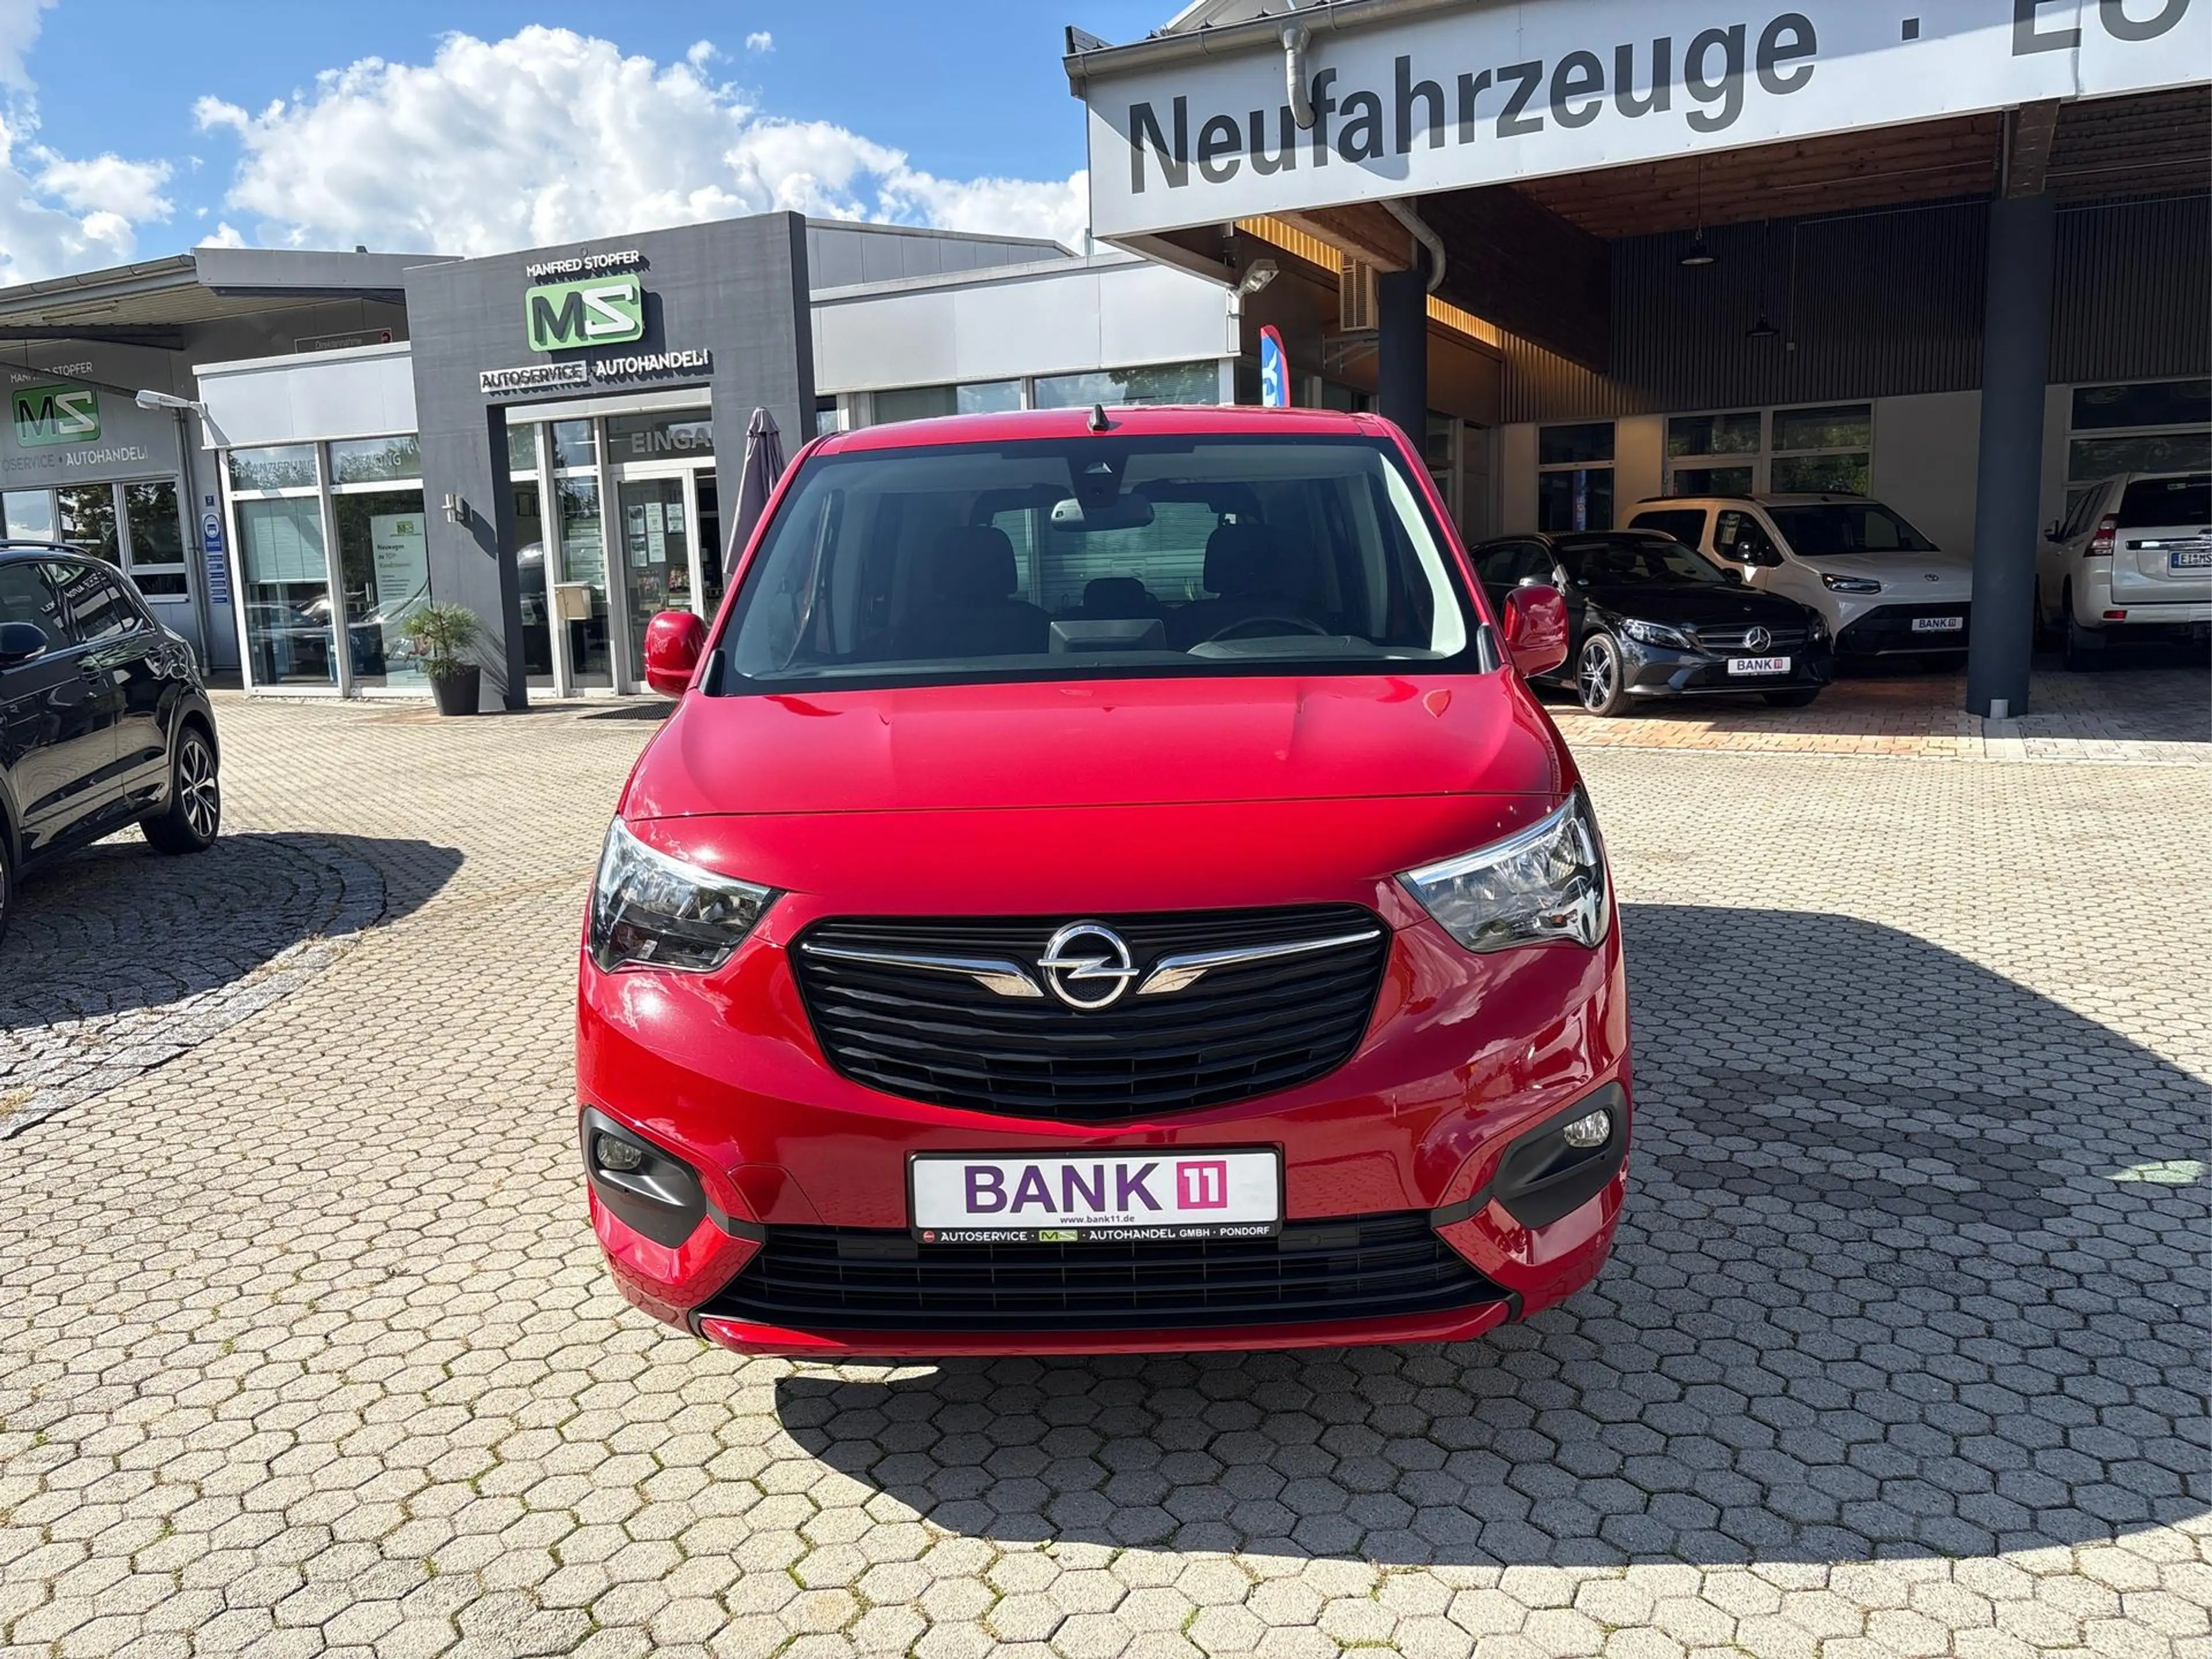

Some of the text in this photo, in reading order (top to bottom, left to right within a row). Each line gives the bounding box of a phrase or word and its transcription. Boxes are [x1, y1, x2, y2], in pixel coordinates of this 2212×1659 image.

[1129, 13, 1818, 195] Neufahrzeuge
[526, 250, 639, 277] MANFRED STOPFER
[482, 363, 583, 388] AUTOSERVICE
[631, 427, 713, 453] EINGA
[1919, 619, 1946, 628] BANK
[1737, 659, 1772, 671] BANK
[965, 1163, 1221, 1213] BANK 11
[1059, 1214, 1135, 1224] www.bank11.de
[941, 1231, 1027, 1241] AUTOSERVICE
[1089, 1229, 1176, 1240] AUTOHANDEL
[1179, 1228, 1210, 1237] GMBH
[1219, 1226, 1270, 1236] PONDORF
